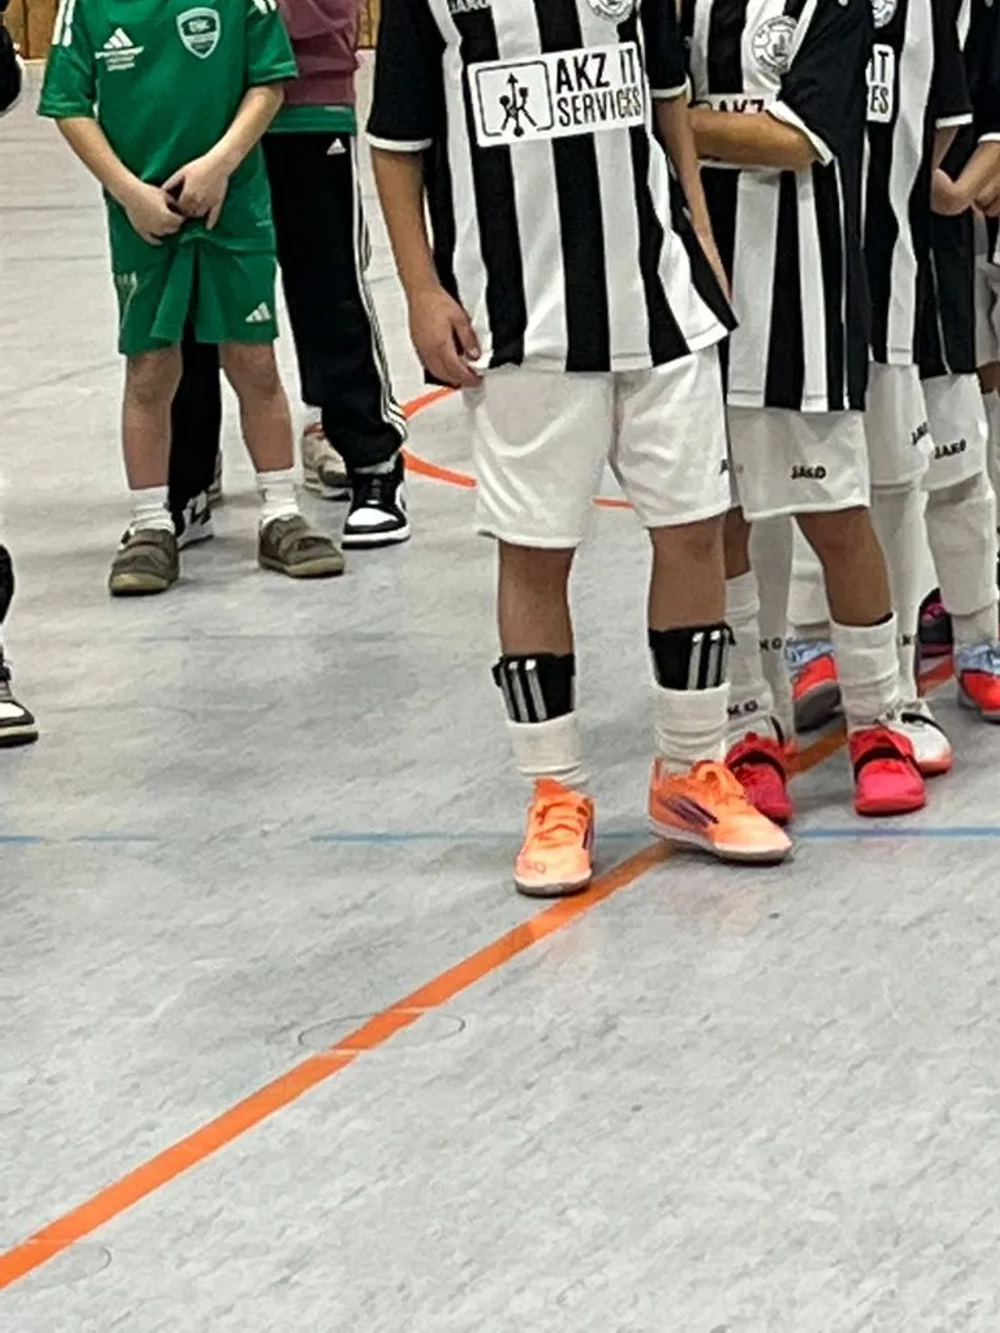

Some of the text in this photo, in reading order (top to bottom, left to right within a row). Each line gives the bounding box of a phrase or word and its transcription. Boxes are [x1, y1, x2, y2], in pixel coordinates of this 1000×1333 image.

[556, 48, 636, 95] AKZ IT
[557, 86, 642, 127] SERVICES
